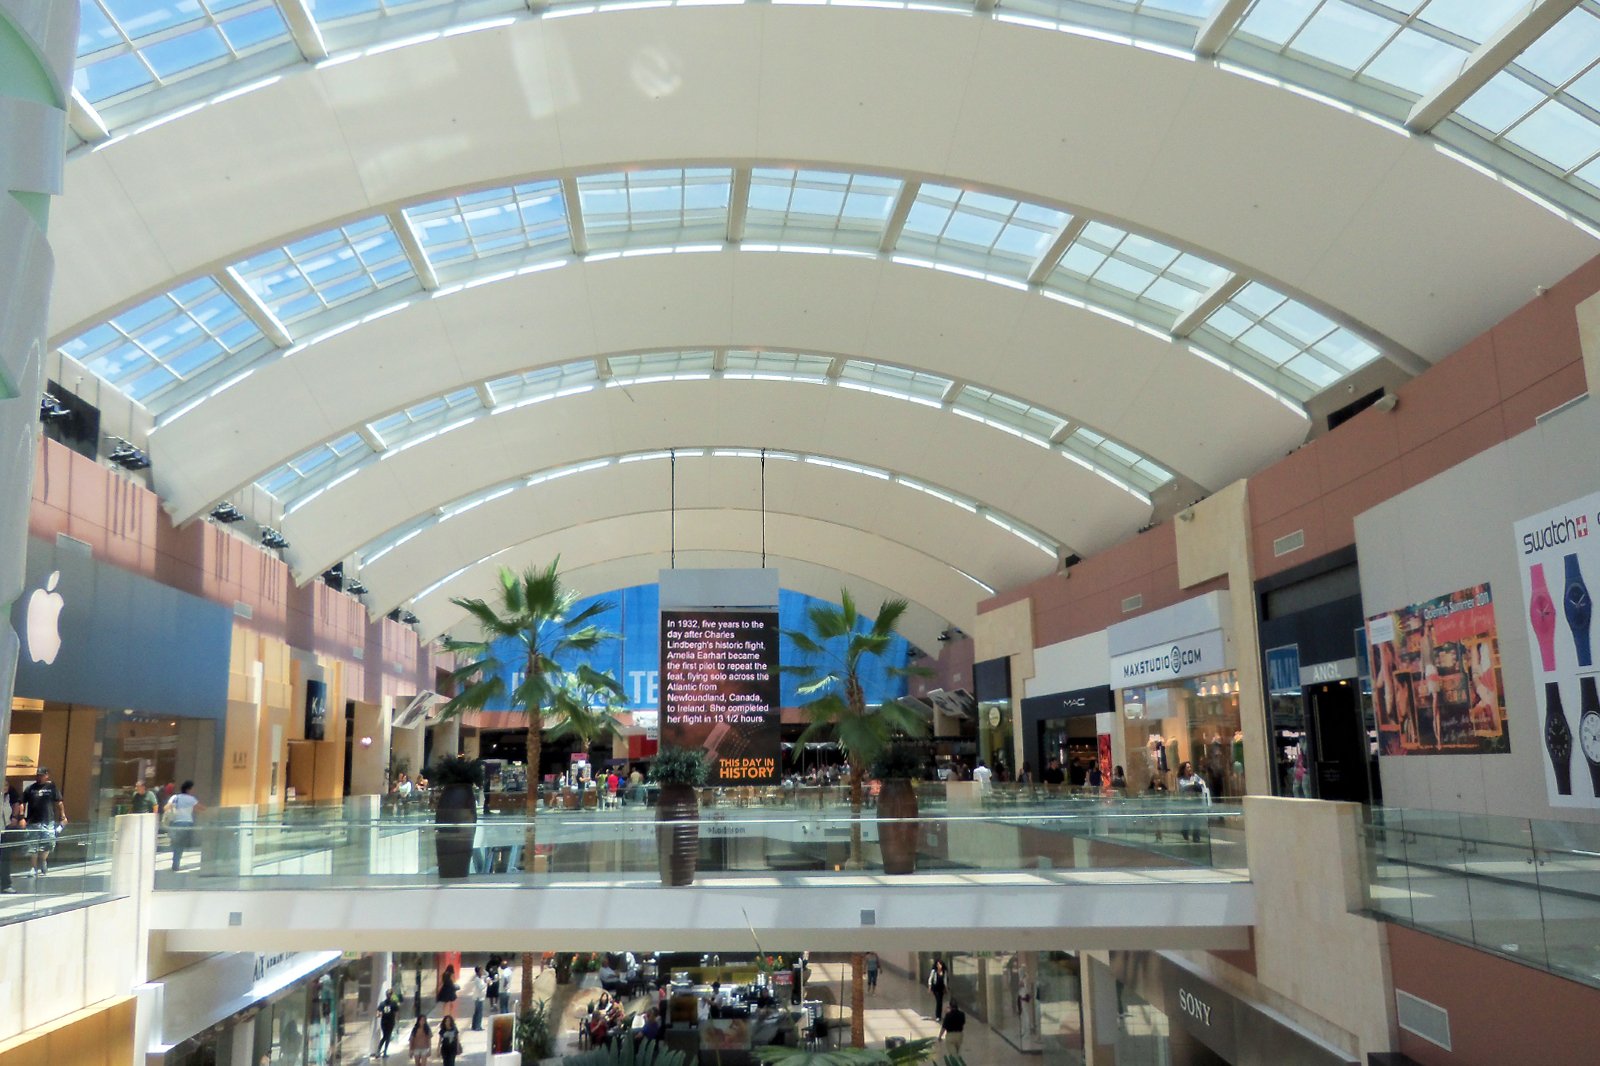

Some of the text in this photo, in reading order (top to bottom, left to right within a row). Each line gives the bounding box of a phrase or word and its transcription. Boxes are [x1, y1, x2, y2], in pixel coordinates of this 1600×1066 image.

[1523, 515, 1577, 555] swatch
[1449, 599, 1475, 614] Summer
[666, 620, 764, 630] In 1932, five years to the
[667, 631, 735, 640] day after Charles
[667, 641, 766, 650] Lindbergh's historic flight,
[667, 651, 760, 660] Amelia Earhart became
[667, 662, 680, 670] the
[682, 662, 697, 670] first
[699, 662, 715, 671] pilot
[727, 663, 753, 671] repeat
[754, 662, 767, 670] the
[667, 672, 685, 681] feat,
[687, 672, 708, 682] flying
[710, 673, 727, 681] solo
[756, 673, 769, 681] the
[1313, 663, 1341, 682] ANGL
[667, 683, 717, 691] Atlantic from
[667, 693, 763, 702] Newfoundland, Canada,
[677, 704, 707, 712] Ireland.
[709, 704, 726, 712] She
[728, 704, 769, 714] completed
[667, 715, 765, 725] her flight in 13 1/2 hours.
[719, 758, 774, 767] THIS DAY IN
[719, 766, 775, 779] HISTORY
[1179, 988, 1211, 1026] SONY
